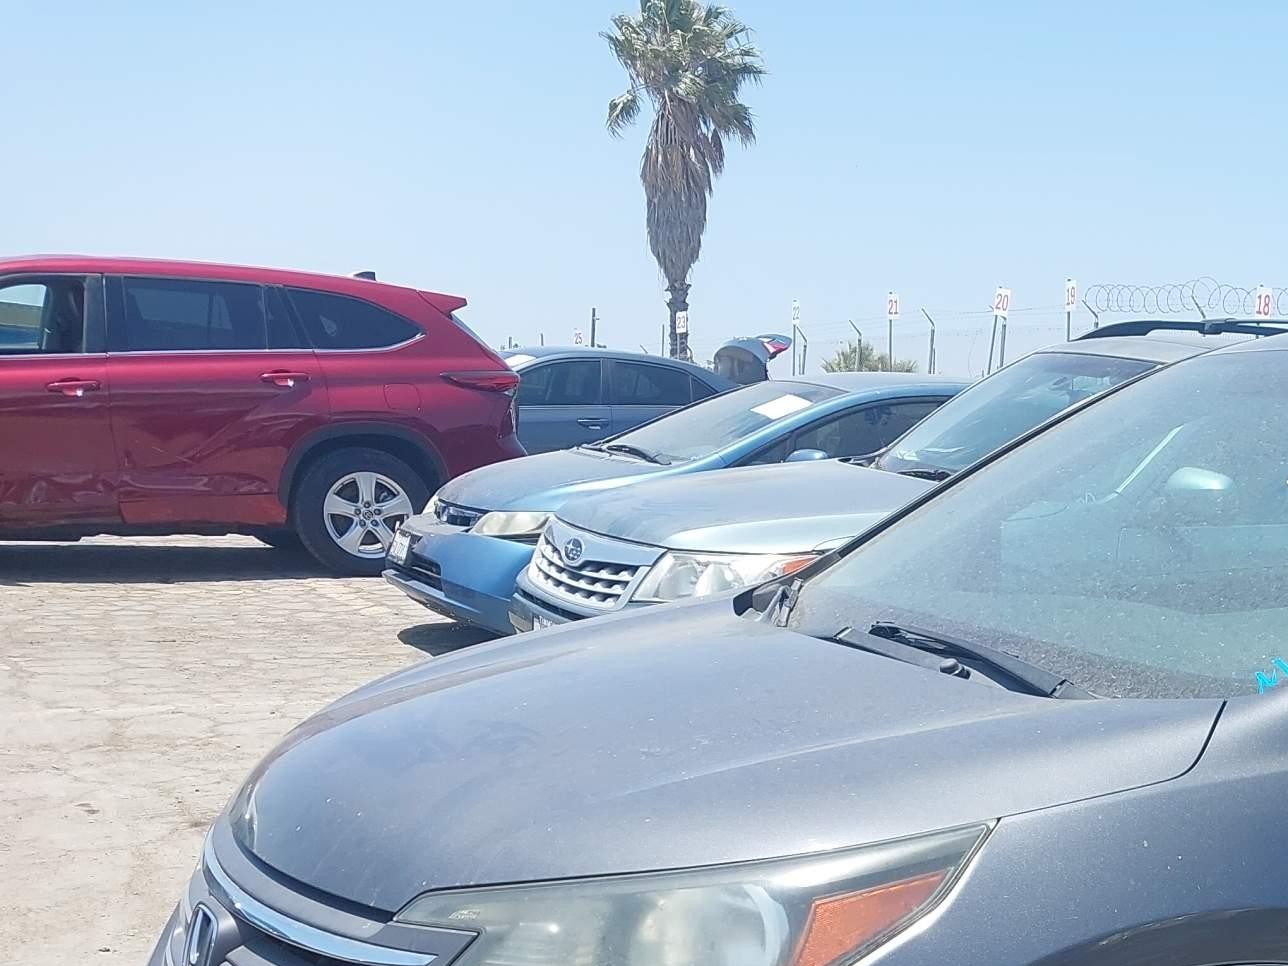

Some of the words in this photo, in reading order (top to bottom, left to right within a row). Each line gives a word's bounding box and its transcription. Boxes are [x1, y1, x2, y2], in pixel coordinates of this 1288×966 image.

[995, 293, 1009, 311] 20
[1066, 286, 1076, 305] 19
[888, 299, 899, 315] 21
[1255, 293, 1271, 316] 18
[677, 315, 686, 329] 23
[574, 332, 583, 345] 25
